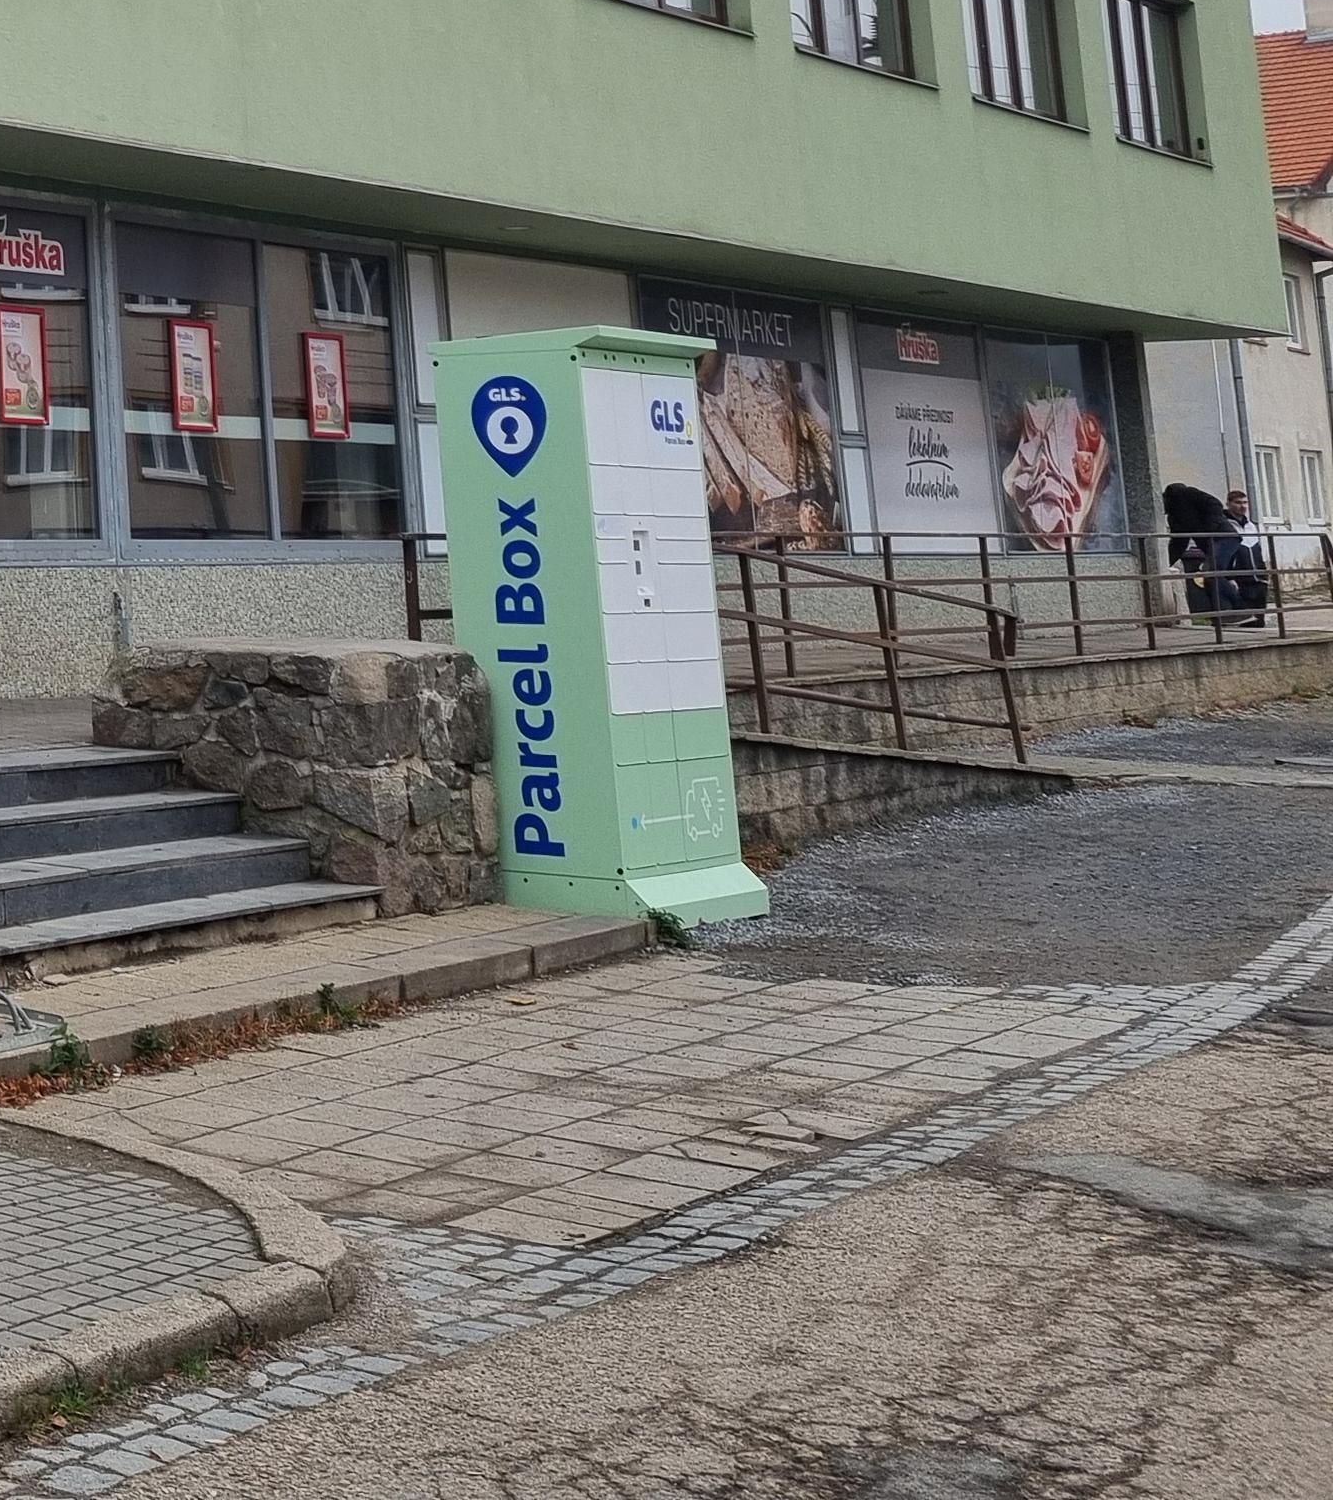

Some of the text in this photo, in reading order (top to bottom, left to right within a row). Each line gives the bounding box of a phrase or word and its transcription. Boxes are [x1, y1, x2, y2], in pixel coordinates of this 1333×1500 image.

[668, 298, 792, 347] SUPERMARKET
[899, 337, 939, 362] Hruška
[495, 498, 566, 858] Parcel Box
